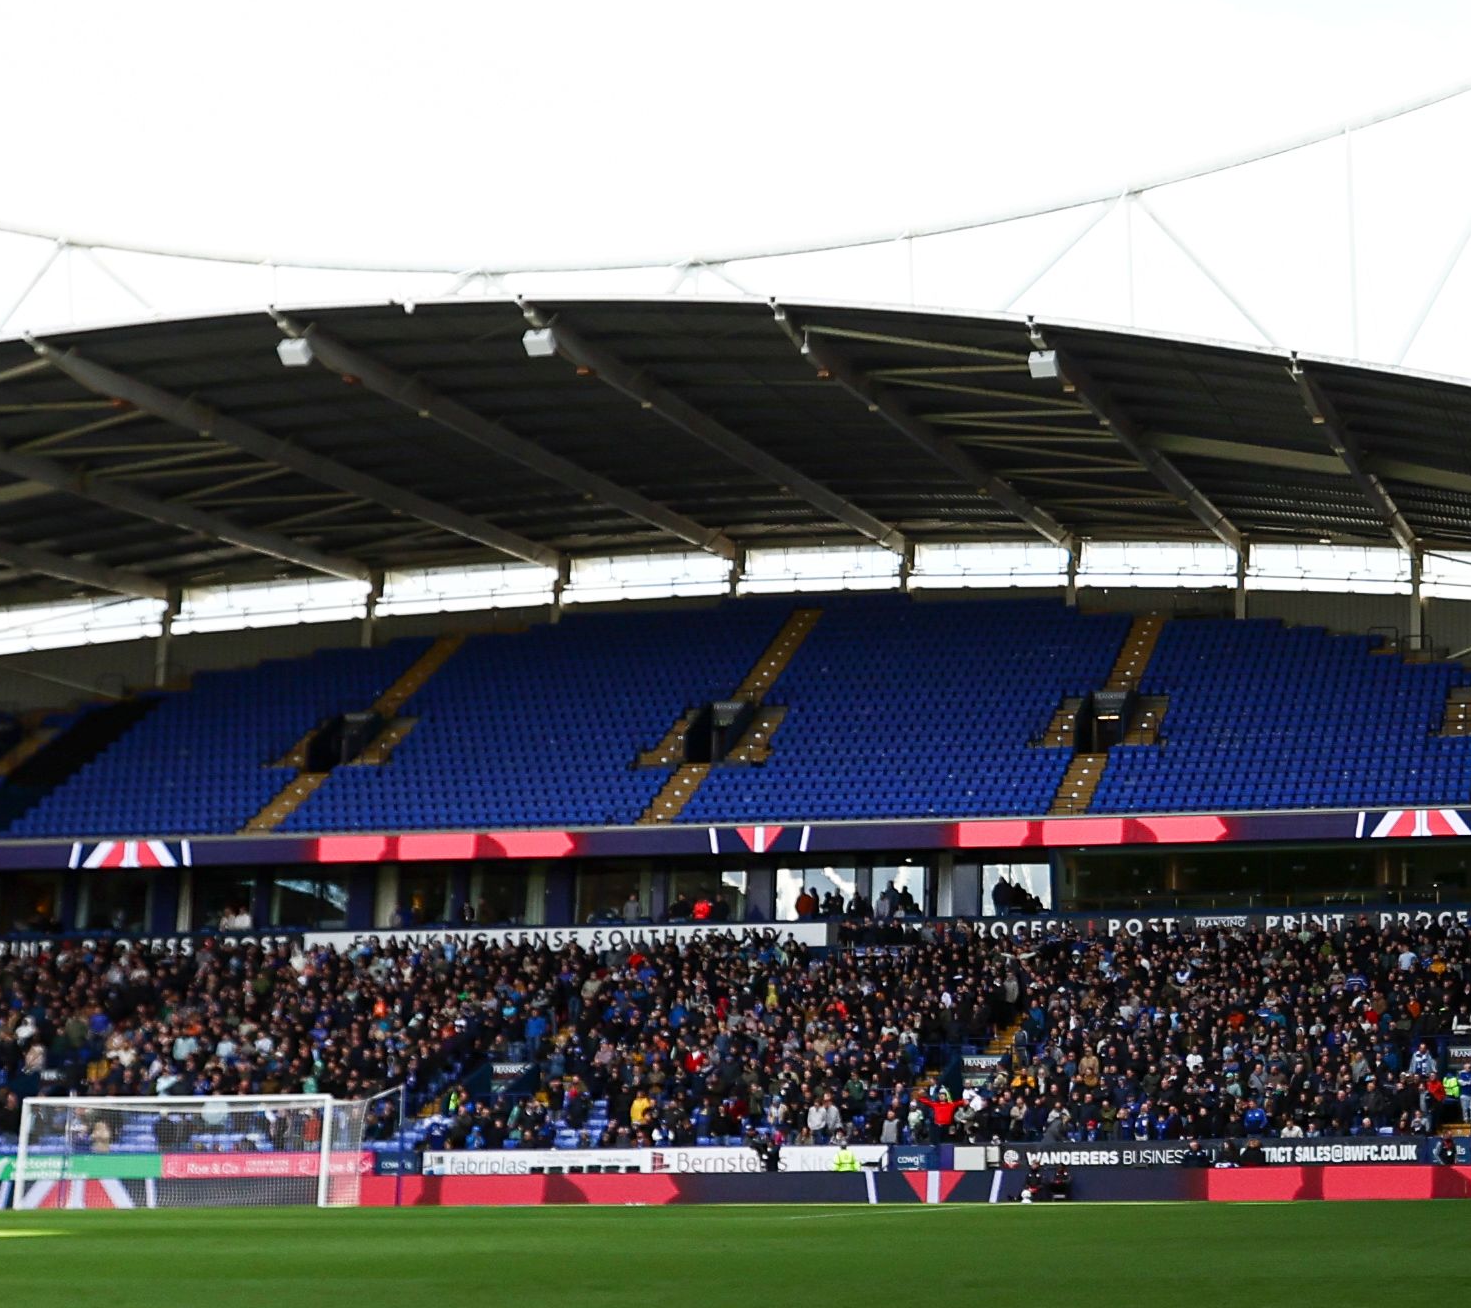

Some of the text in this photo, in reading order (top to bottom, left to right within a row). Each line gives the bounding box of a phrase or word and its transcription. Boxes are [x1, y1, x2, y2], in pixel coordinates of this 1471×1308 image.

[1027, 1151, 1119, 1165] WANDERERS
[1295, 1144, 1417, 1162] SALES@BWFC.CO.UK
[450, 1156, 528, 1176] fabriplas
